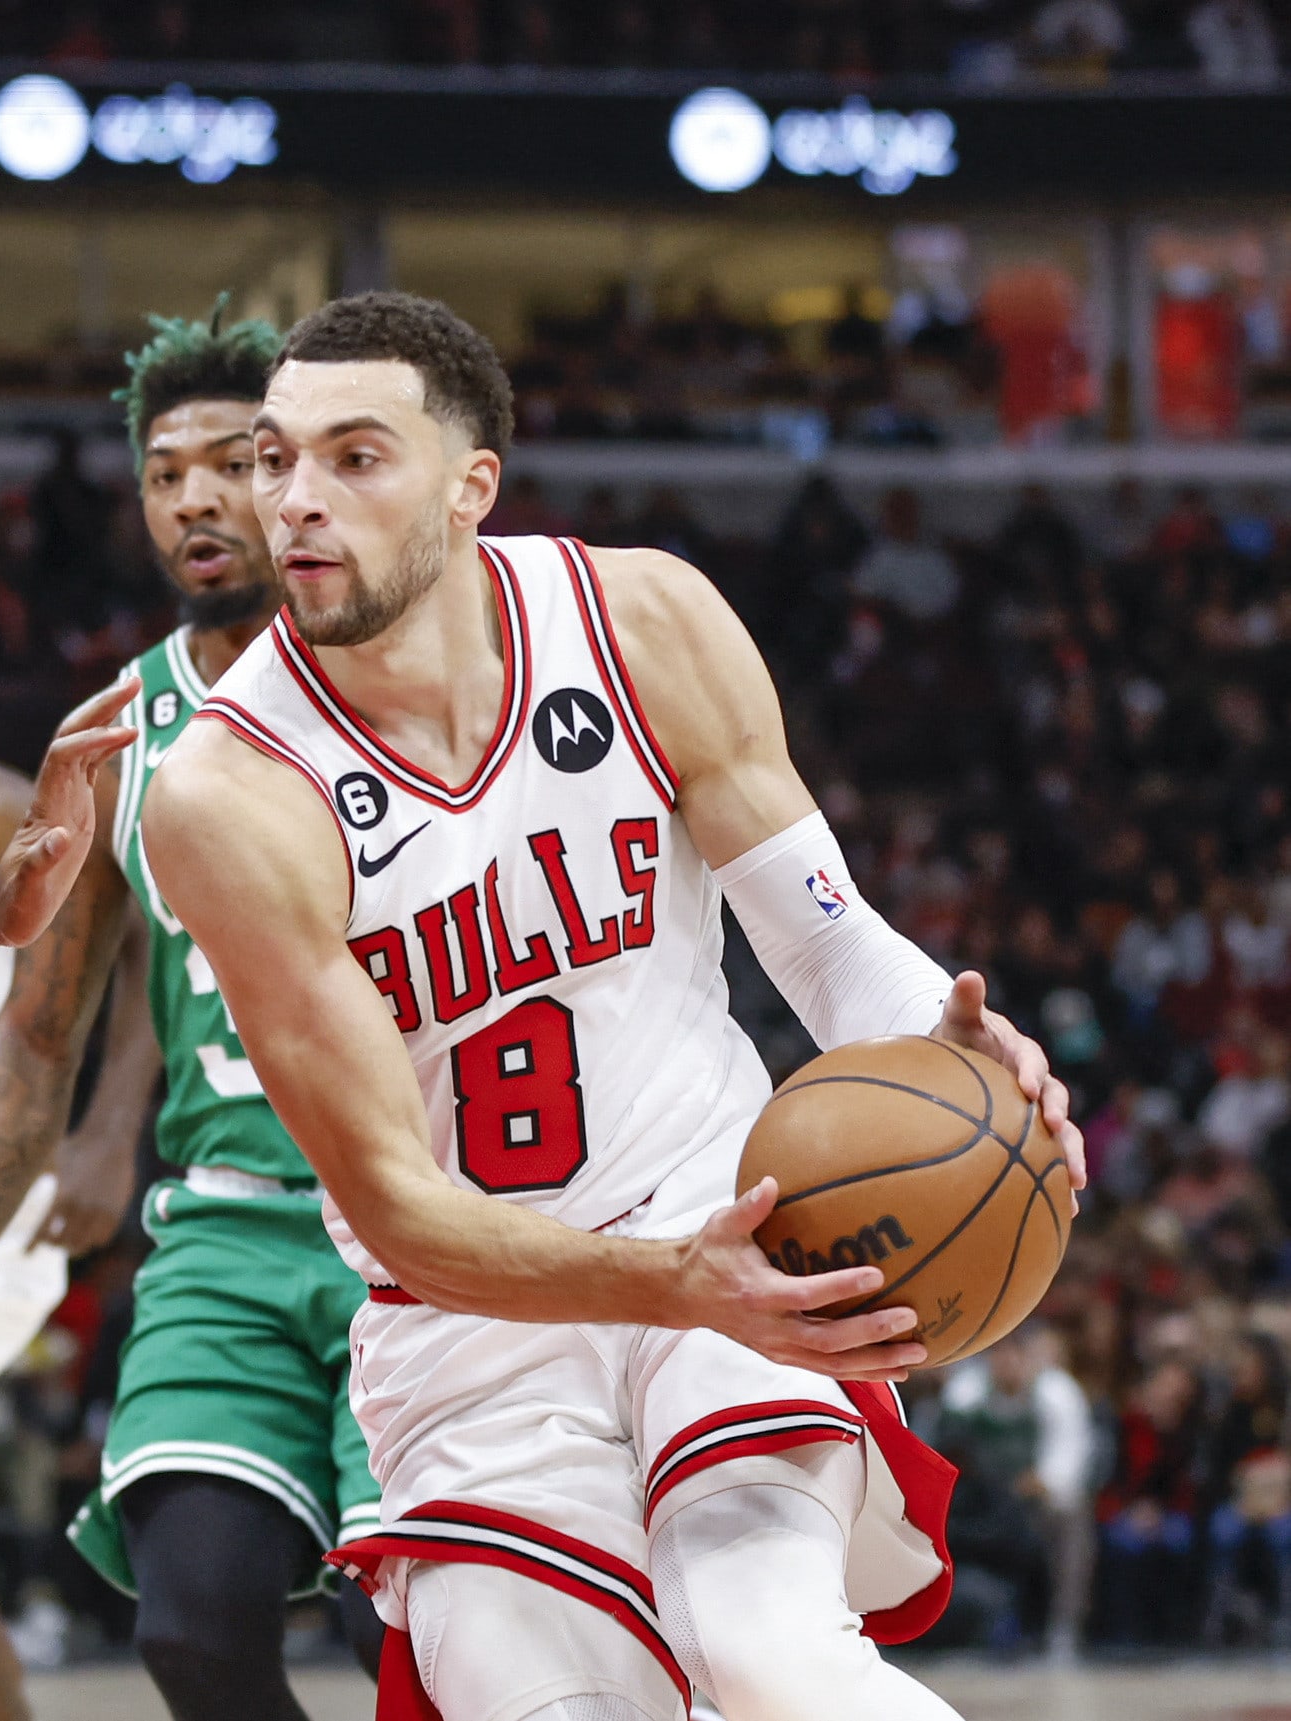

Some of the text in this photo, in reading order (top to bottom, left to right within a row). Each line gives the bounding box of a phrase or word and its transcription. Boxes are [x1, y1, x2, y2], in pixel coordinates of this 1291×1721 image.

[153, 693, 177, 728] 6
[341, 779, 378, 825] 6
[346, 817, 659, 1034] BULLS
[451, 995, 588, 1195] 8
